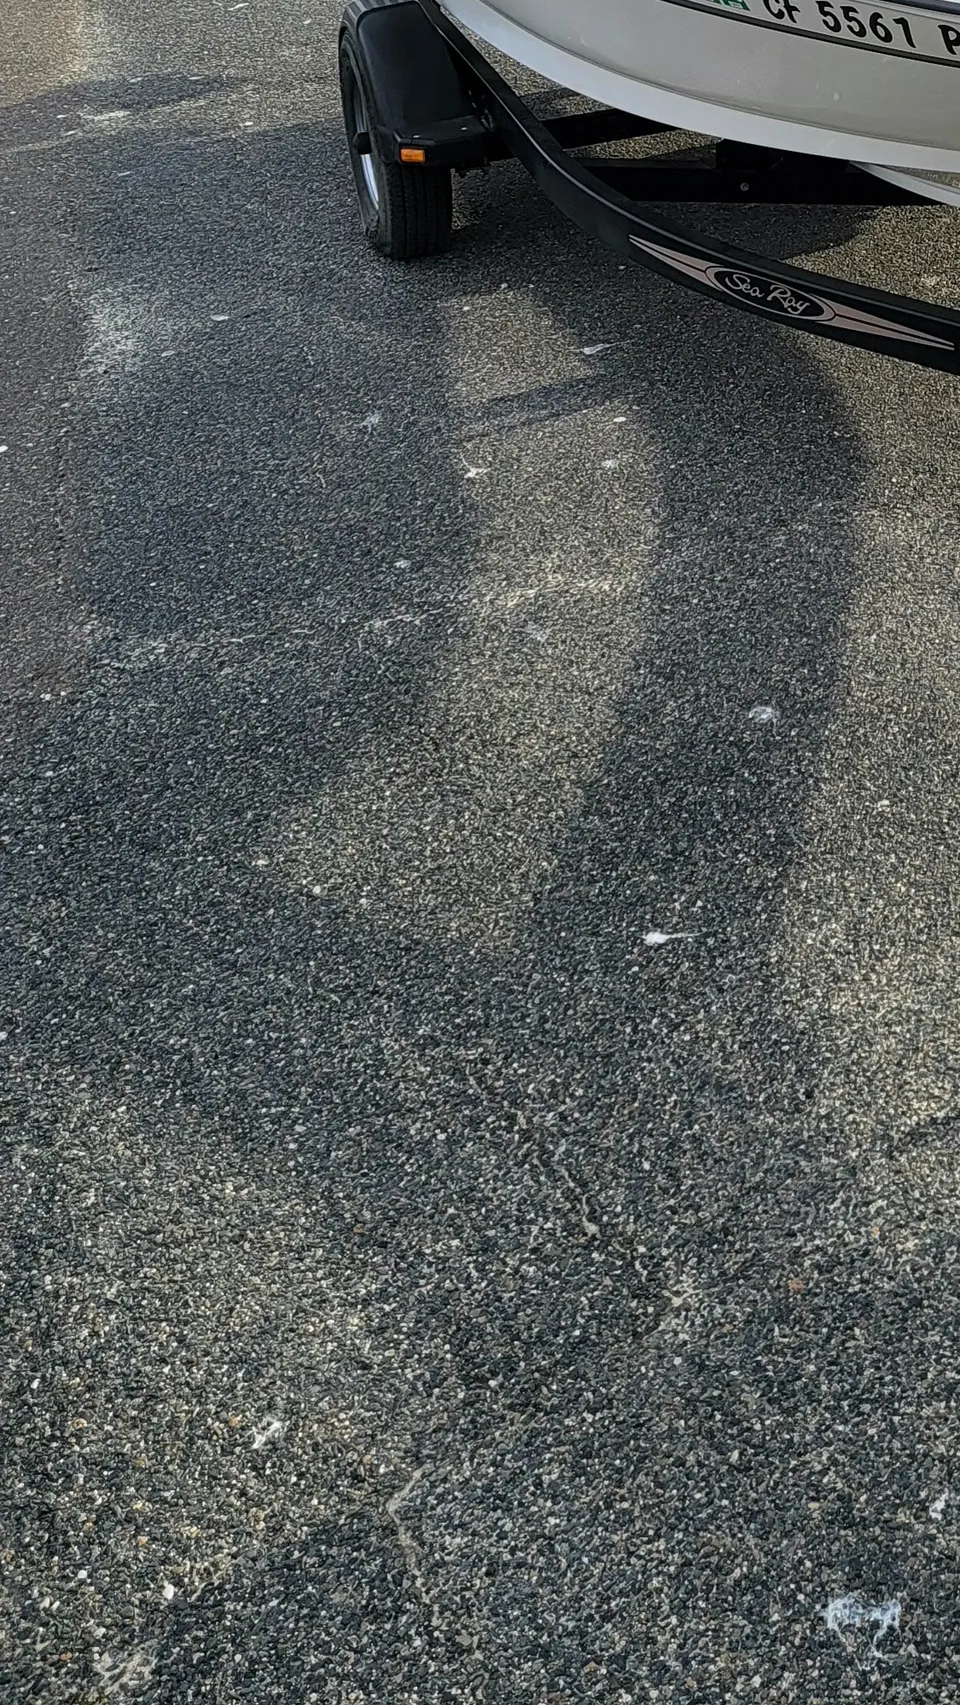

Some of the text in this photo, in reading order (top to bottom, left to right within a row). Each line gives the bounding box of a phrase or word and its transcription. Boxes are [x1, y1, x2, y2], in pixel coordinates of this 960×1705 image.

[815, 0, 917, 49] 5561
[725, 274, 811, 315] Sea Ray
